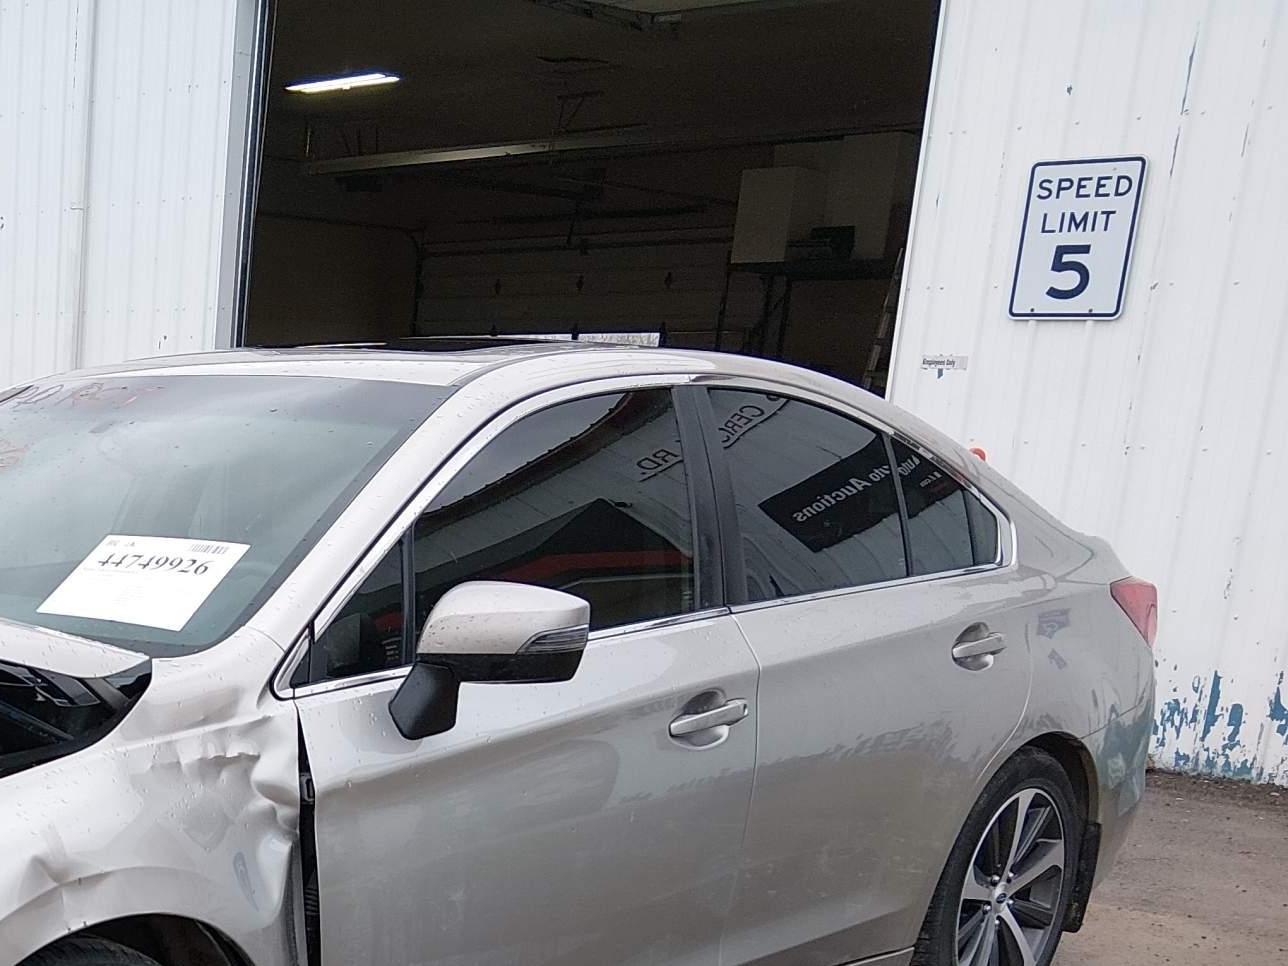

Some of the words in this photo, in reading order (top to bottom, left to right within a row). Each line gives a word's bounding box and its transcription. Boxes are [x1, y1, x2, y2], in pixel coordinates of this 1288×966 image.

[1036, 175, 1133, 200] SPEED
[1041, 210, 1117, 234] LIMIT
[1045, 244, 1092, 300] 5
[98, 553, 213, 576] 44749926
